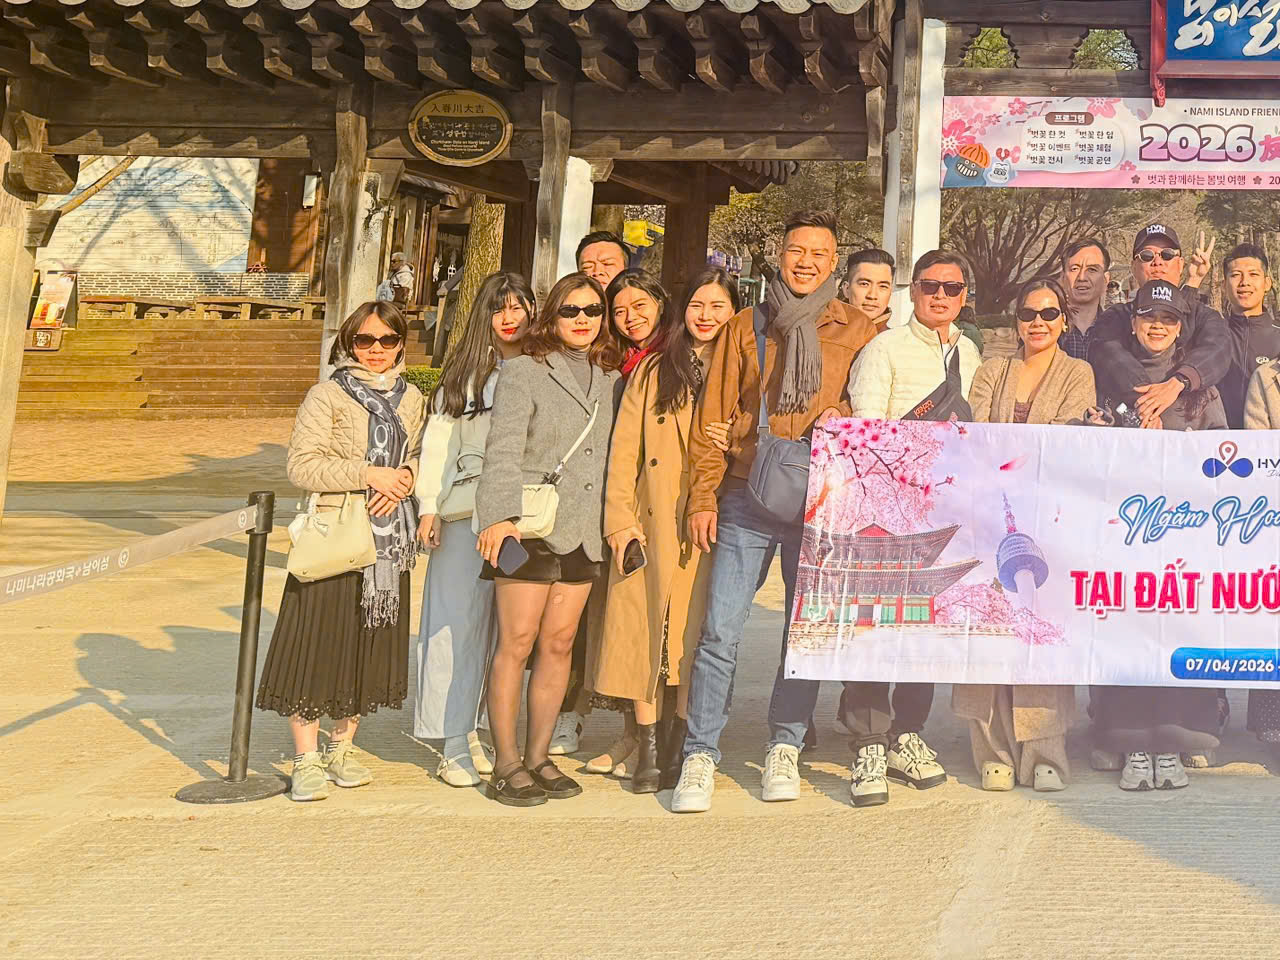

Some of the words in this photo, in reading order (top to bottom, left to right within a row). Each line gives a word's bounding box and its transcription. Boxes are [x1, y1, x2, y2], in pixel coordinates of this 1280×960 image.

[1054, 114, 1086, 124] 프로그램
[1189, 107, 1214, 117] NAMI
[1215, 107, 1250, 117] ISLAND
[1139, 123, 1257, 163] 2026
[1168, 175, 1205, 185] 함께하는
[1227, 175, 1246, 186] 여행
[1151, 286, 1172, 297] HVN
[1118, 494, 1210, 546] Ngắm
[82, 555, 110, 577] 남이섬
[1070, 570, 1123, 617] TẠI
[1133, 558, 1202, 612] ĐẤT
[1185, 658, 1275, 673] 07/04/2026
